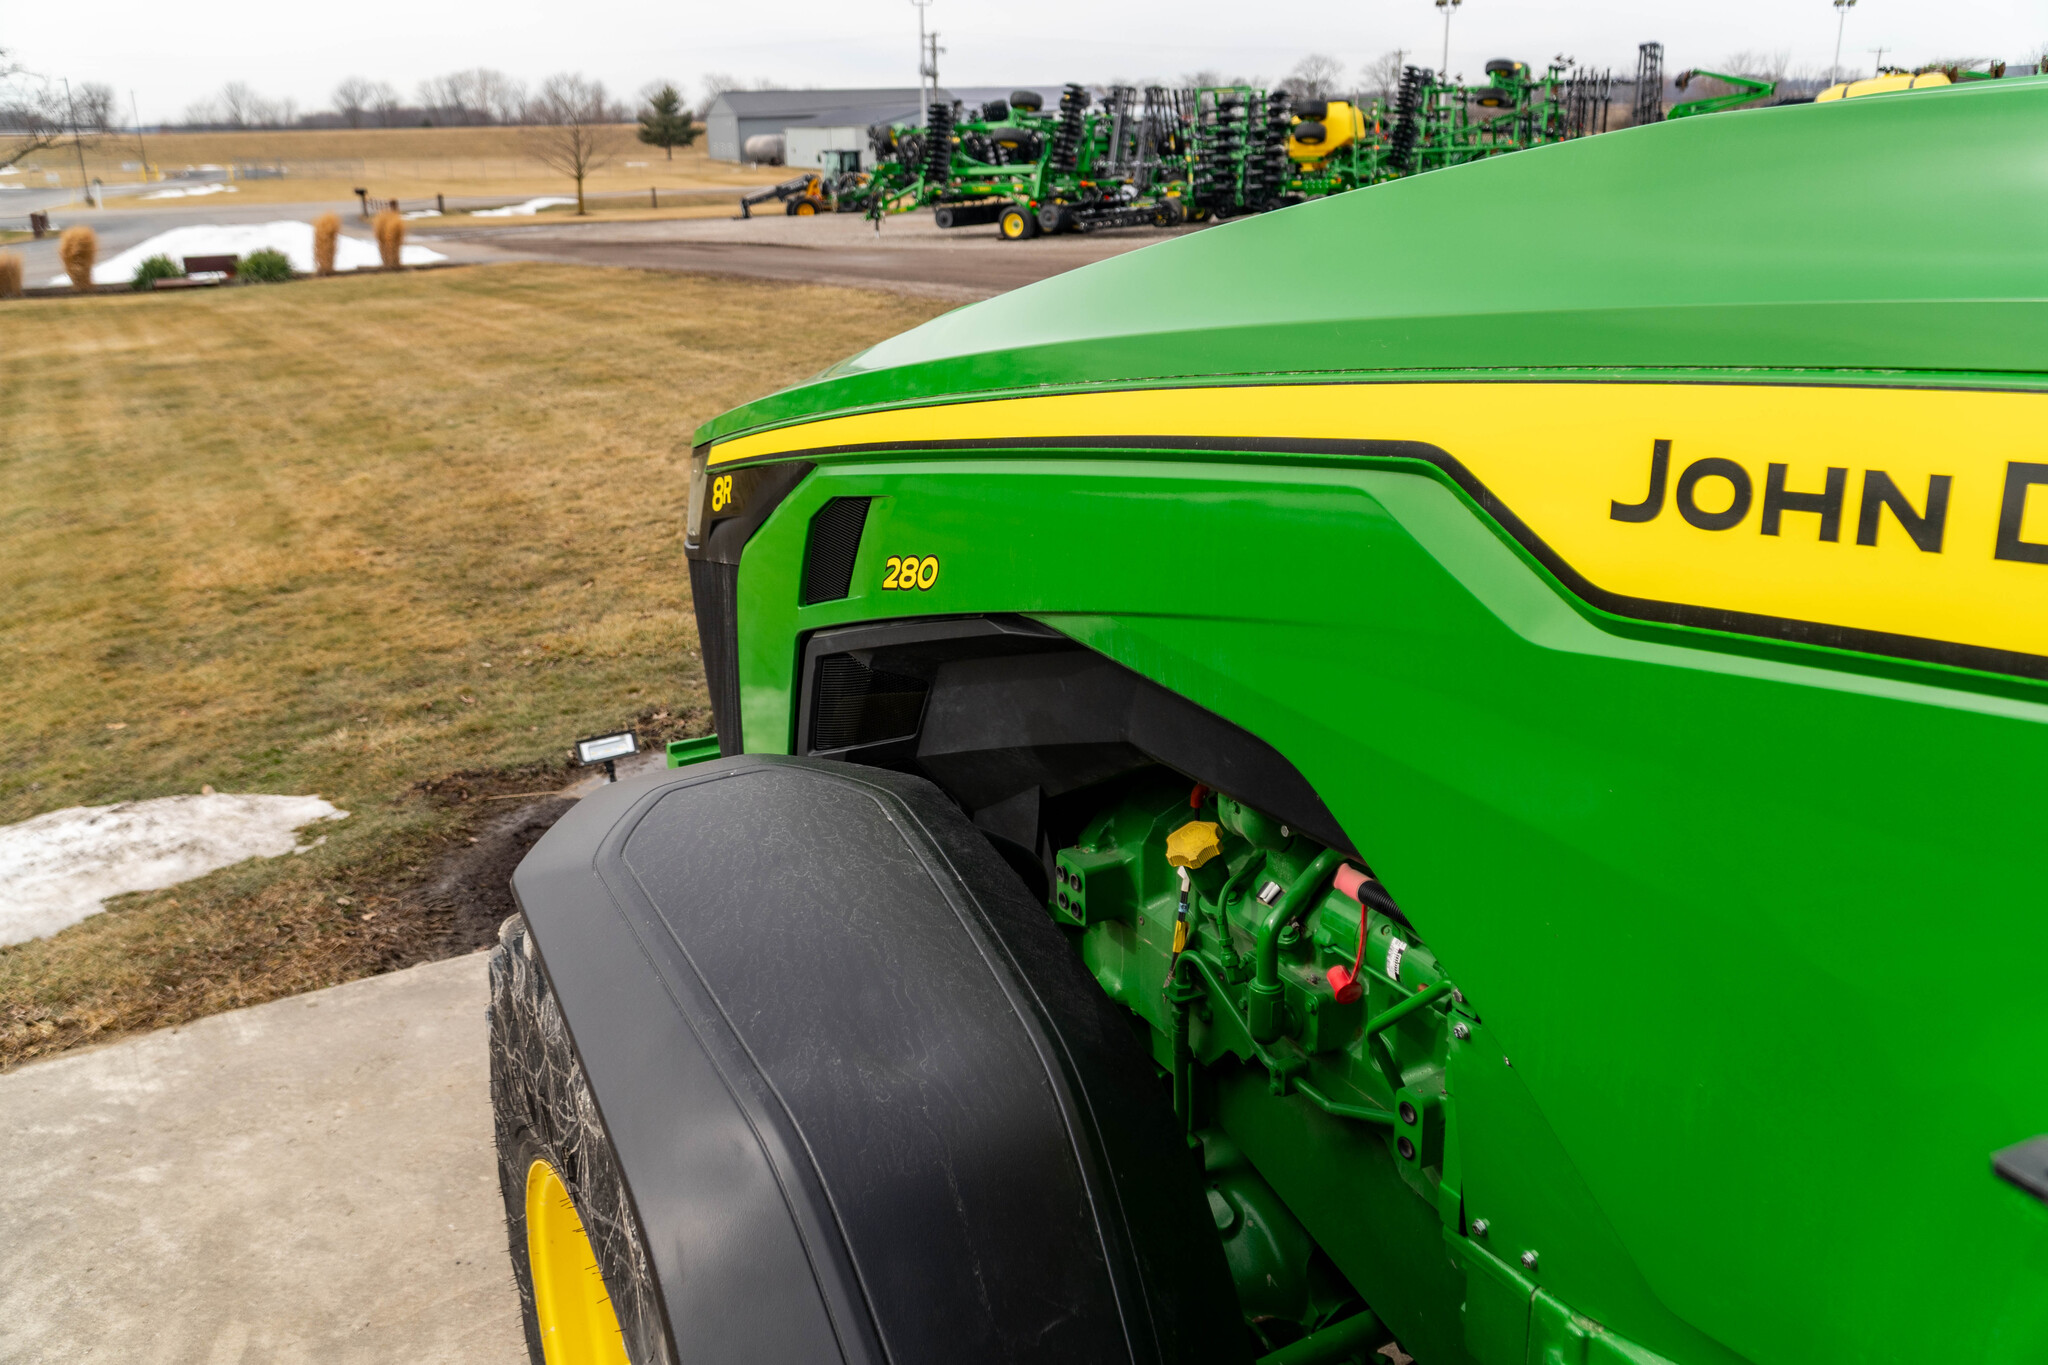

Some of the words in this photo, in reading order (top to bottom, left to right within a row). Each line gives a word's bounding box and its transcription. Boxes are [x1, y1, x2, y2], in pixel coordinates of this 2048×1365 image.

[711, 474, 733, 513] 8R
[1610, 439, 1954, 554] JOHN
[881, 553, 940, 592] 280
